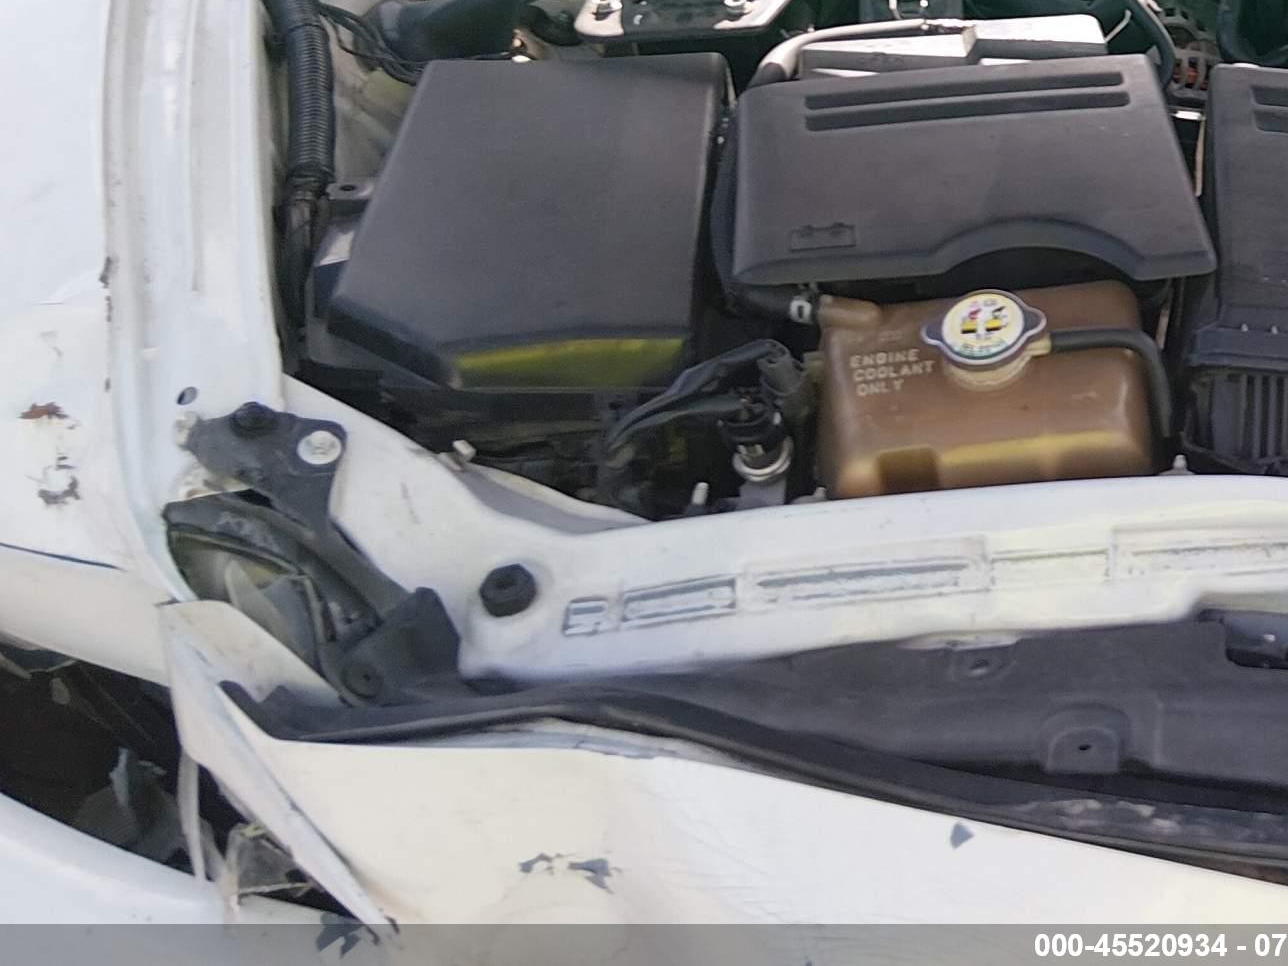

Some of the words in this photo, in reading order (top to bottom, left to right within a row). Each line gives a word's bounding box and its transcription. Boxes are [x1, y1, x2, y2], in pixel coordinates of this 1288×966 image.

[849, 348, 919, 368] ENGINE
[853, 360, 936, 382] COOLANT
[857, 379, 905, 396] ONLY
